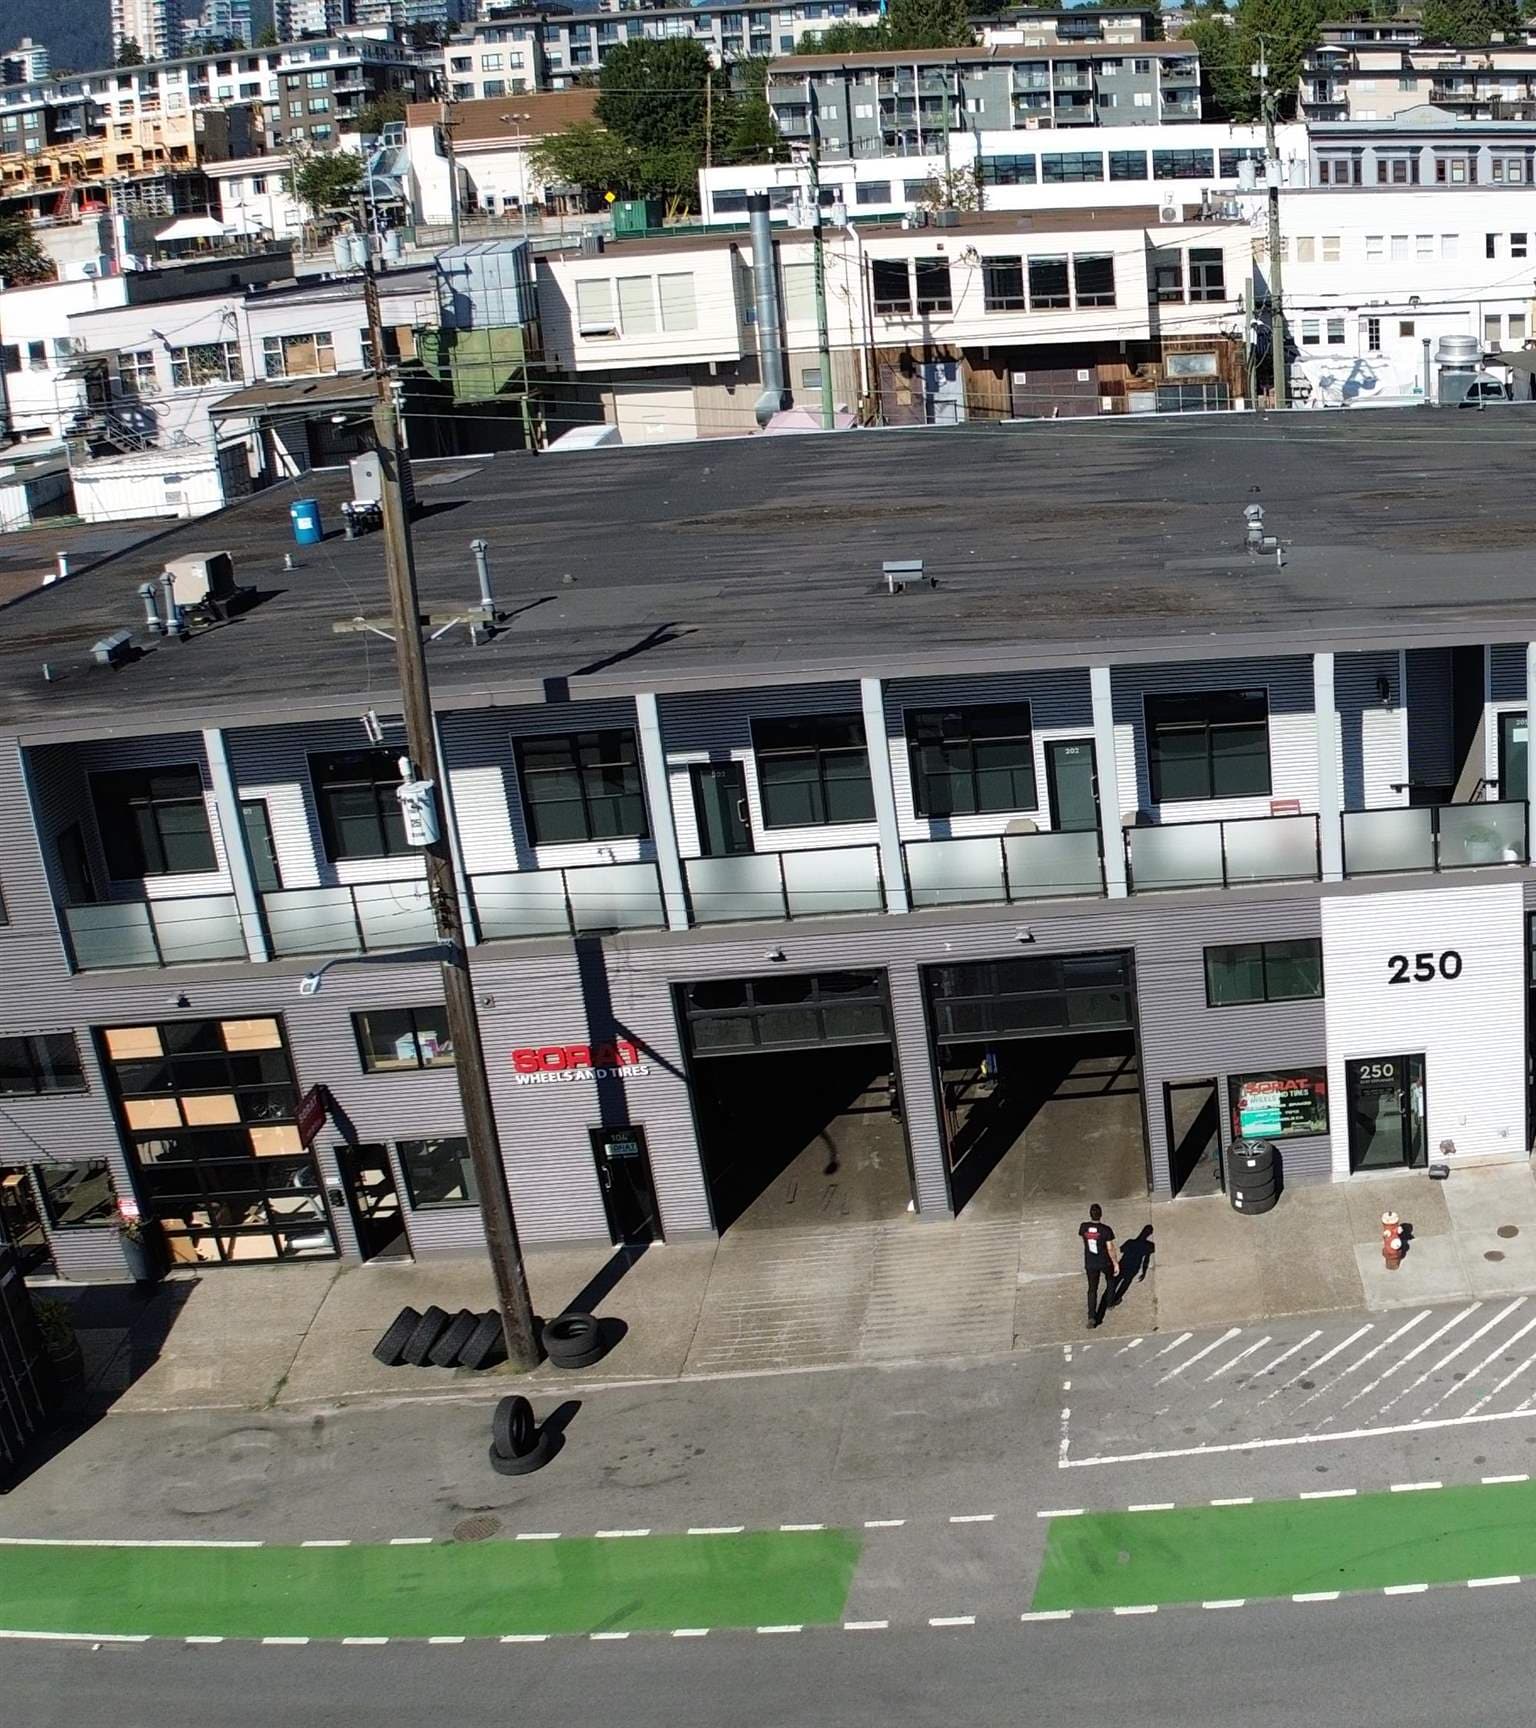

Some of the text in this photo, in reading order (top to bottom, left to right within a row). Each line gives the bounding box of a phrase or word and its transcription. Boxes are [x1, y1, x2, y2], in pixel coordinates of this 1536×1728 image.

[1387, 950, 1463, 985] 250
[511, 1041, 640, 1073] SORAT
[514, 1065, 650, 1085] WHEELS AND TIRES
[1359, 1063, 1394, 1080] 250
[1245, 1078, 1309, 1095] SORAT
